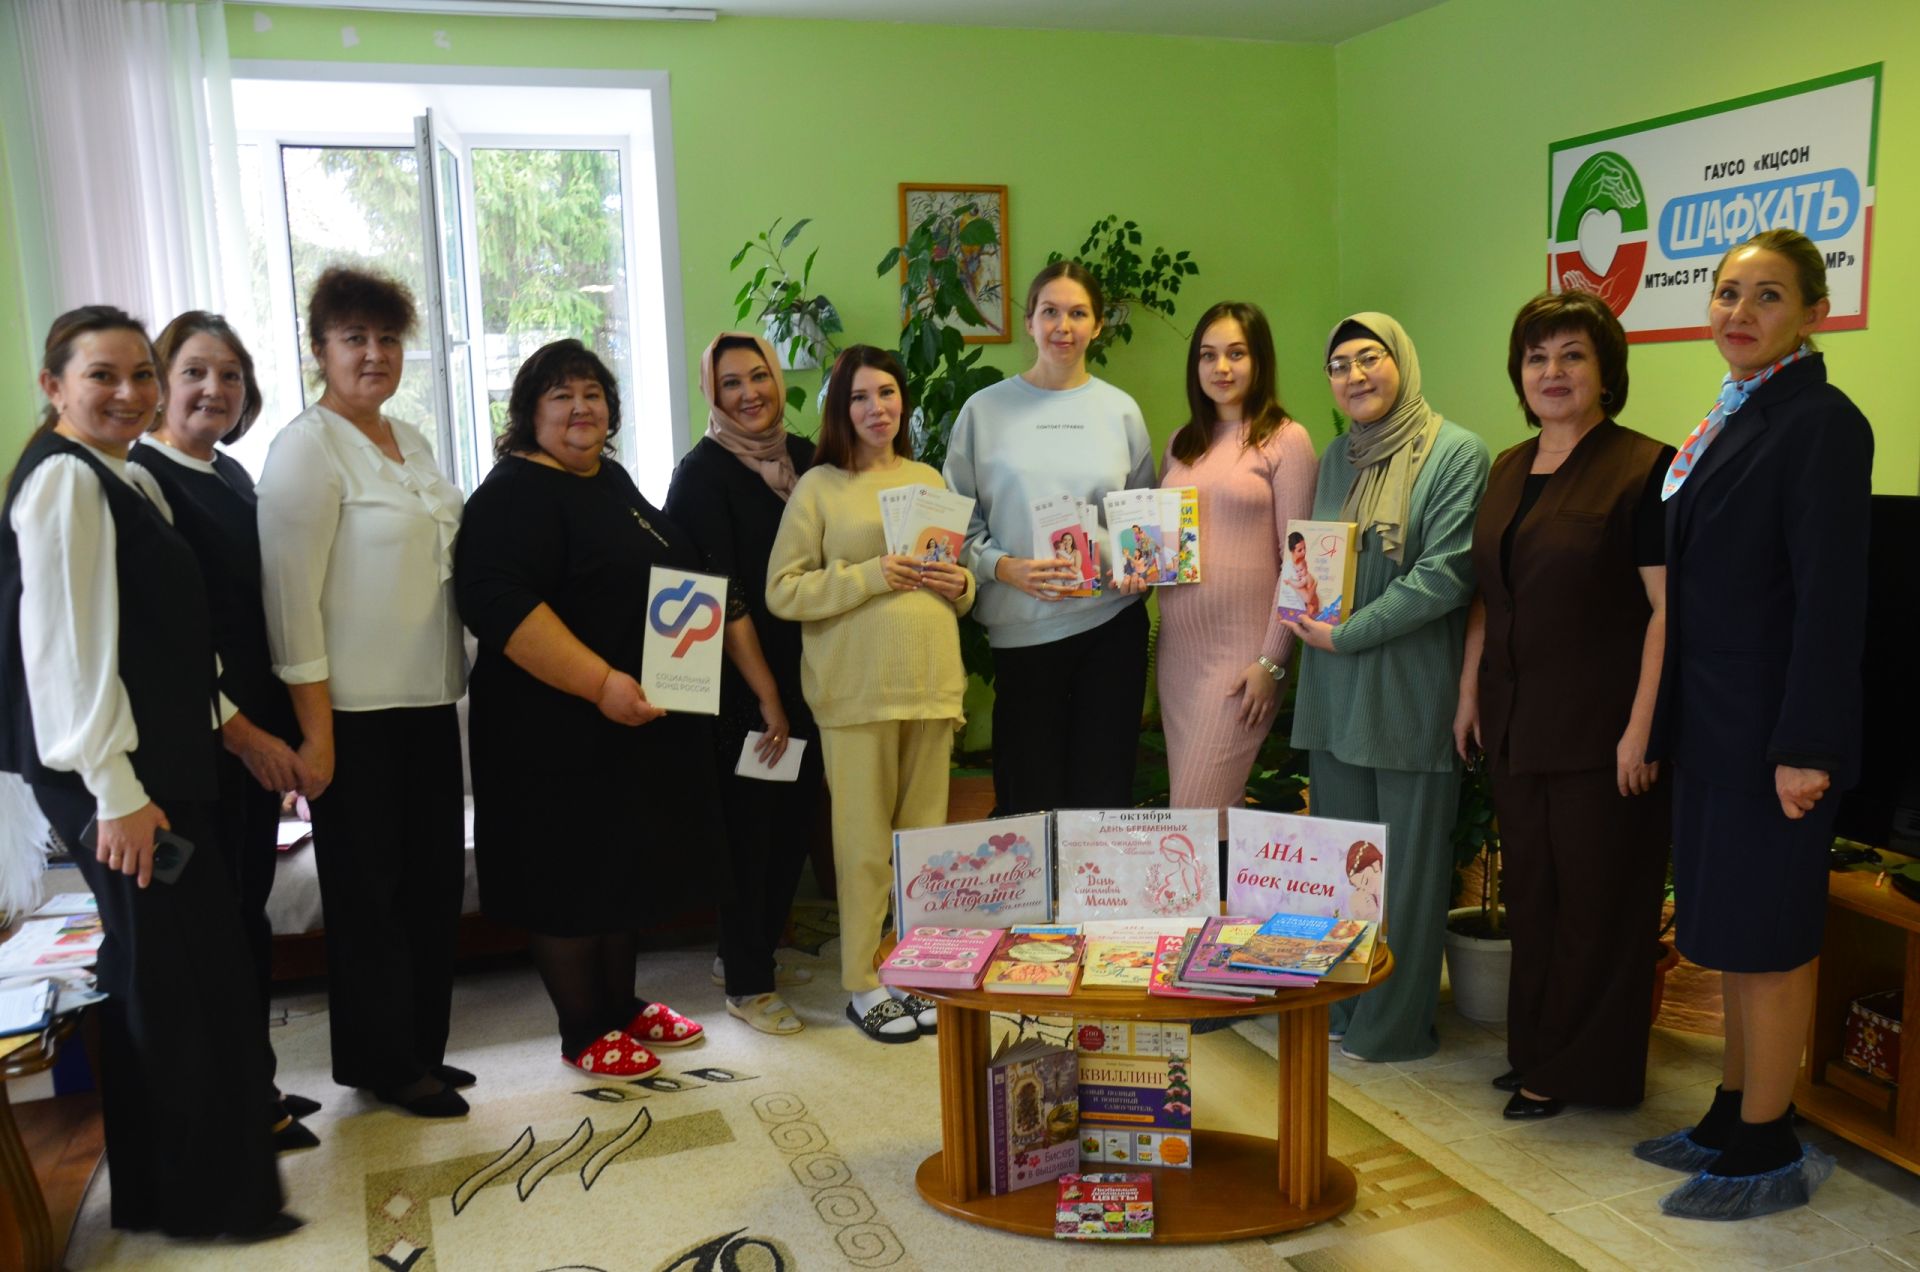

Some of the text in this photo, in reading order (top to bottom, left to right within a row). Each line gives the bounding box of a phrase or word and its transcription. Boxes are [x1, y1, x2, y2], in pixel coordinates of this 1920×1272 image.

[1704, 146, 1810, 181] ГАУСО «КЦСОН
[1669, 179, 1850, 250] ШАФКАТЬ
[1645, 270, 1689, 288] МТЗиСЗ
[1693, 267, 1708, 283] РТ
[1099, 812, 1105, 822] 7
[1120, 811, 1172, 823] октября
[1255, 841, 1303, 864] АНА
[906, 860, 1042, 899] Счастливое
[1286, 879, 1336, 898] исем
[924, 887, 1026, 912] ожидание
[1085, 895, 1128, 906] Мамы
[1080, 1068, 1167, 1085] КВИЛЛИНГ
[1044, 1147, 1075, 1163] Бисер
